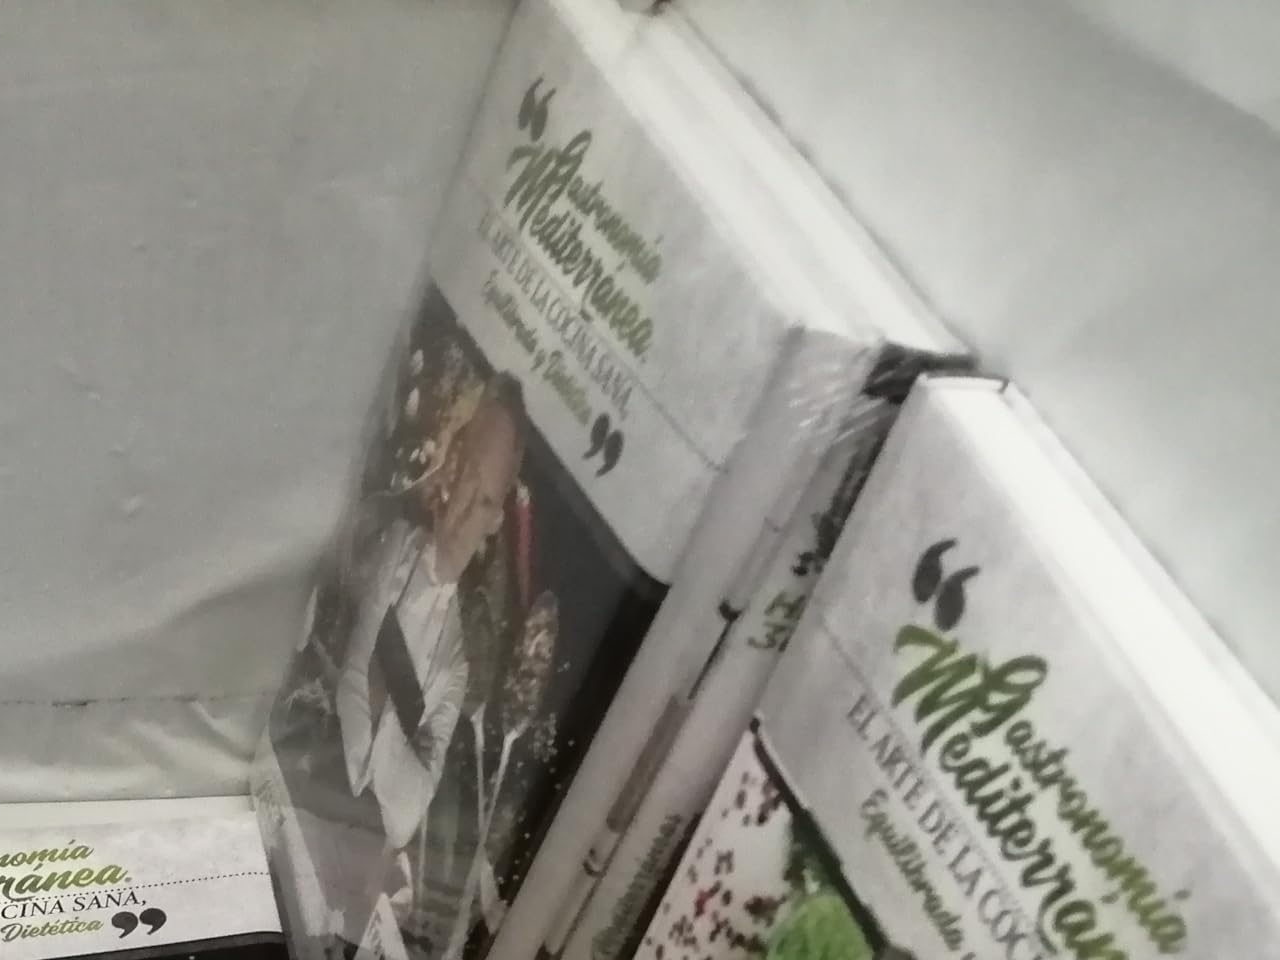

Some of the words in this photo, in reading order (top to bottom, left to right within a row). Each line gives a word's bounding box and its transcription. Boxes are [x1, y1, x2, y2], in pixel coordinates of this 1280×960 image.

[847, 695, 877, 740] EL
[918, 801, 954, 855] DE
[948, 845, 983, 896] LA
[72, 890, 147, 912] SANA,
[0, 916, 104, 942] Dietética
